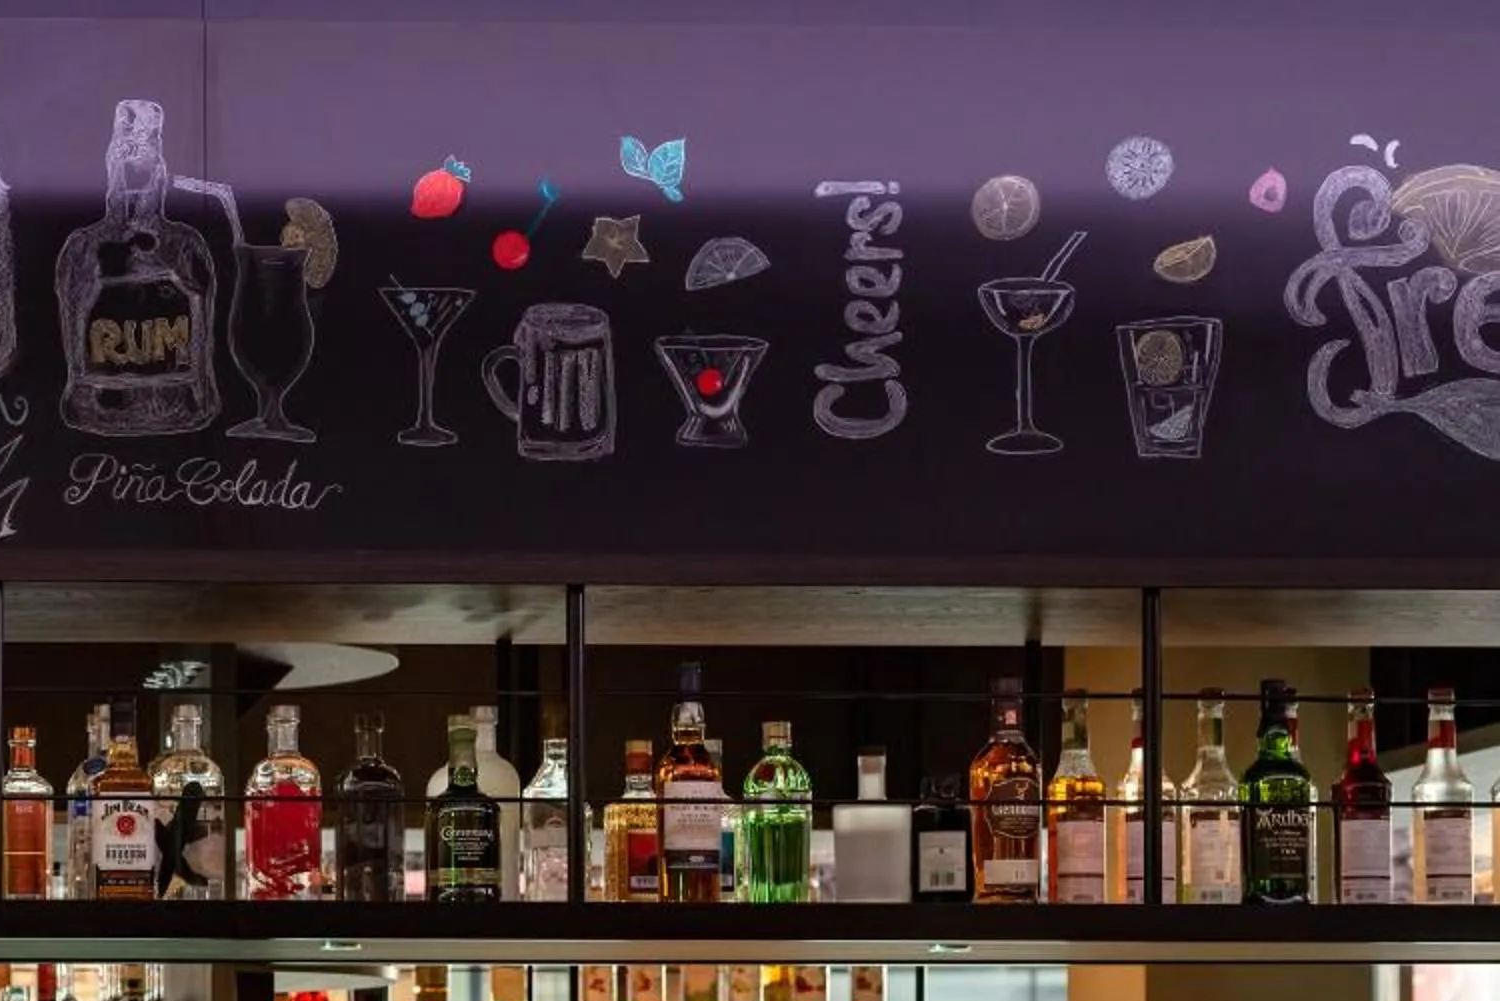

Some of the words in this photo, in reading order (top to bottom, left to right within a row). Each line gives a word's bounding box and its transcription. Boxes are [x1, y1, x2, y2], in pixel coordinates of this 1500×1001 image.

[91, 313, 190, 364] RUM
[813, 181, 908, 439] Cheers!
[64, 452, 184, 504] Piña
[176, 457, 344, 509] Colada
